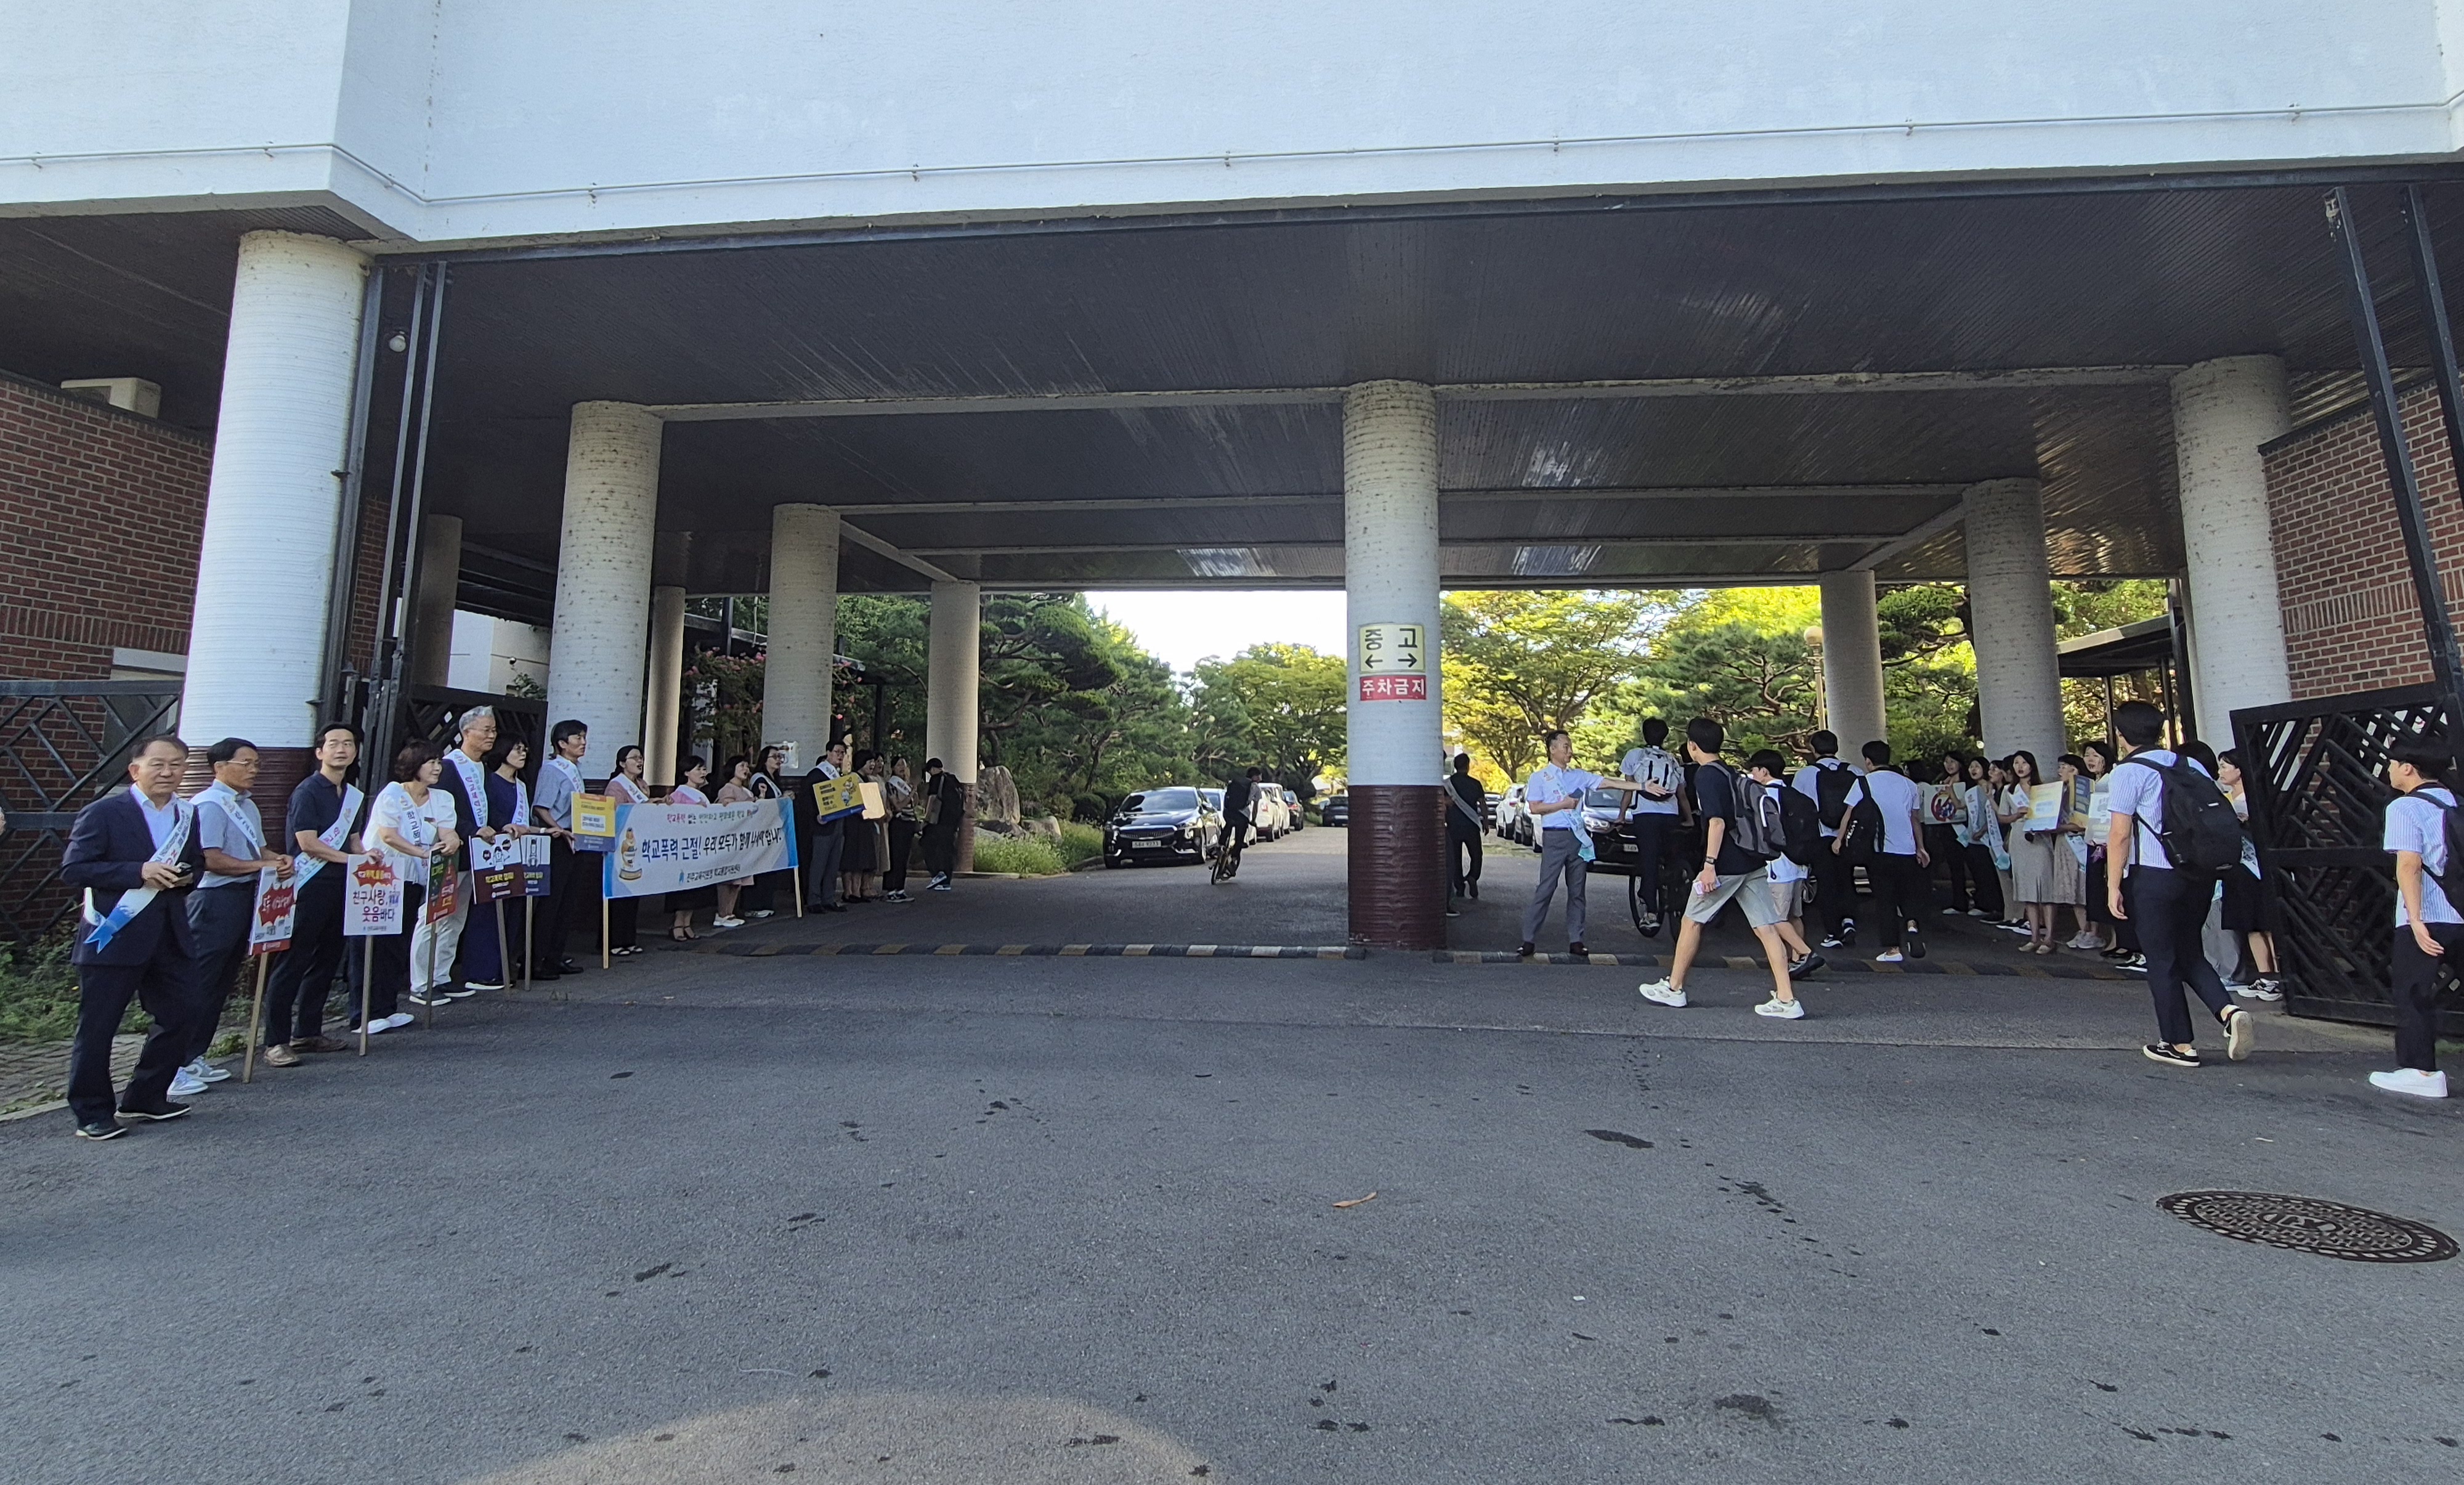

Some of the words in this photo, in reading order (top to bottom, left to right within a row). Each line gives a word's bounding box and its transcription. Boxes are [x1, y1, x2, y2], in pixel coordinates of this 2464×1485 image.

[1364, 629, 1383, 650] 중
[1398, 628, 1418, 648] 고
[1362, 678, 1424, 696] 주차금지
[642, 838, 678, 863] 학교폭력
[681, 836, 702, 860] 근절!
[703, 836, 718, 856] 우리
[718, 833, 738, 852] 모두가
[353, 889, 388, 906] 친구사랑,
[362, 906, 395, 922] 웃음바다
